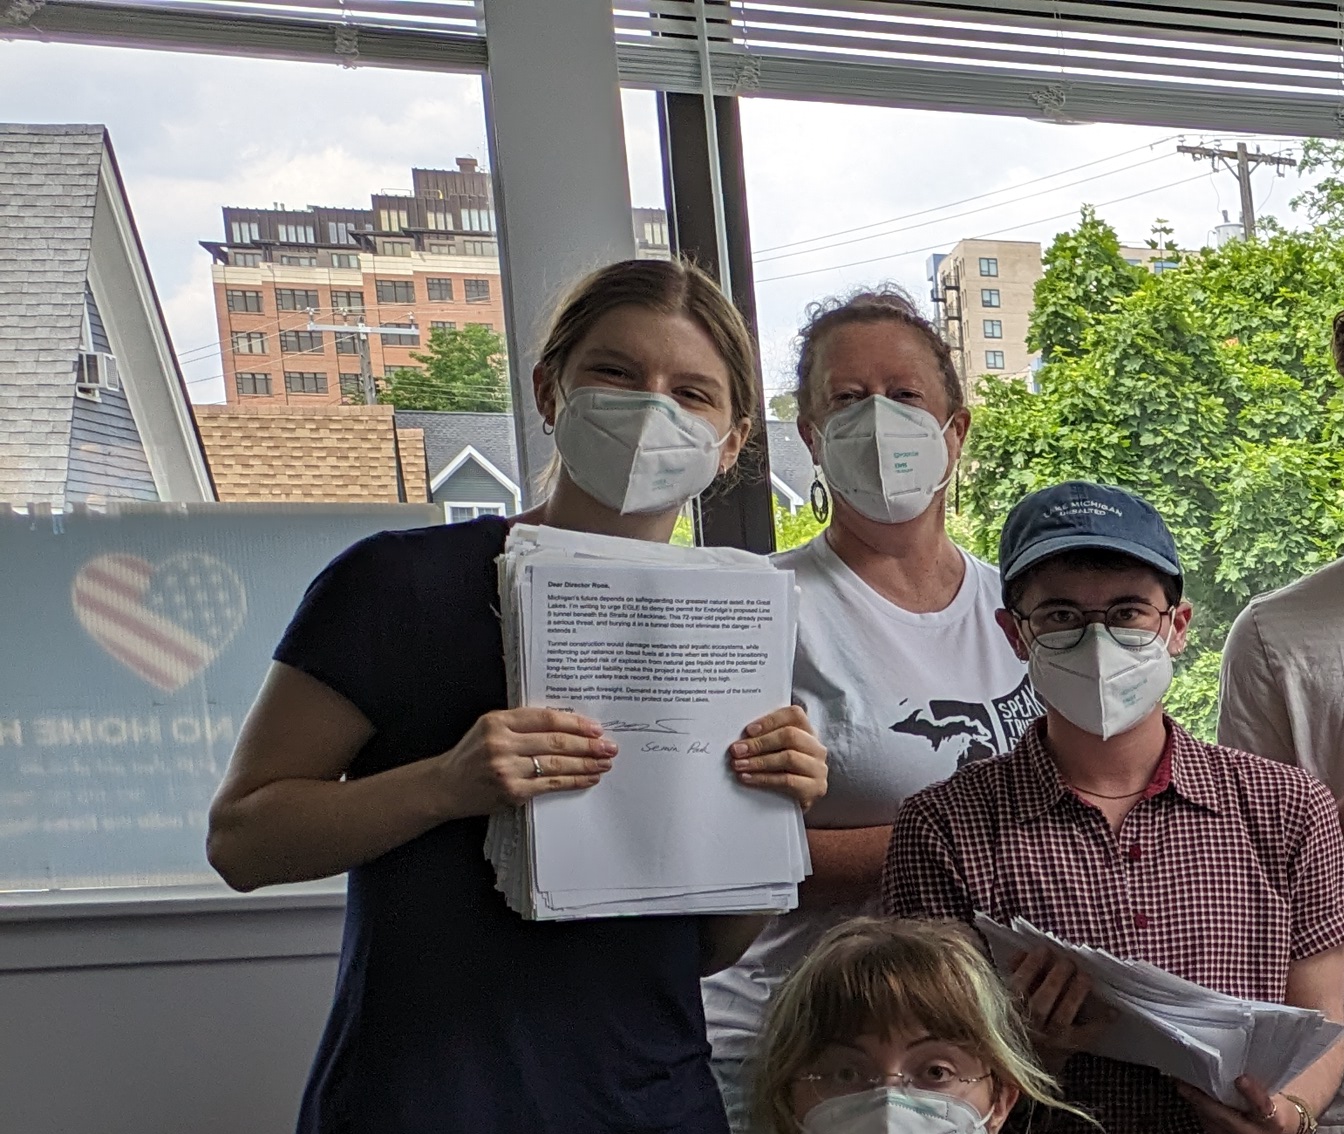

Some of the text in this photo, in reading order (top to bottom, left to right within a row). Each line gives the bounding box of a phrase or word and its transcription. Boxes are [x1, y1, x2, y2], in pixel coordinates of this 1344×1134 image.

[1070, 500, 1122, 517] MICHIGAN
[563, 580, 590, 588] Director
[997, 684, 1048, 718] SPEAK
